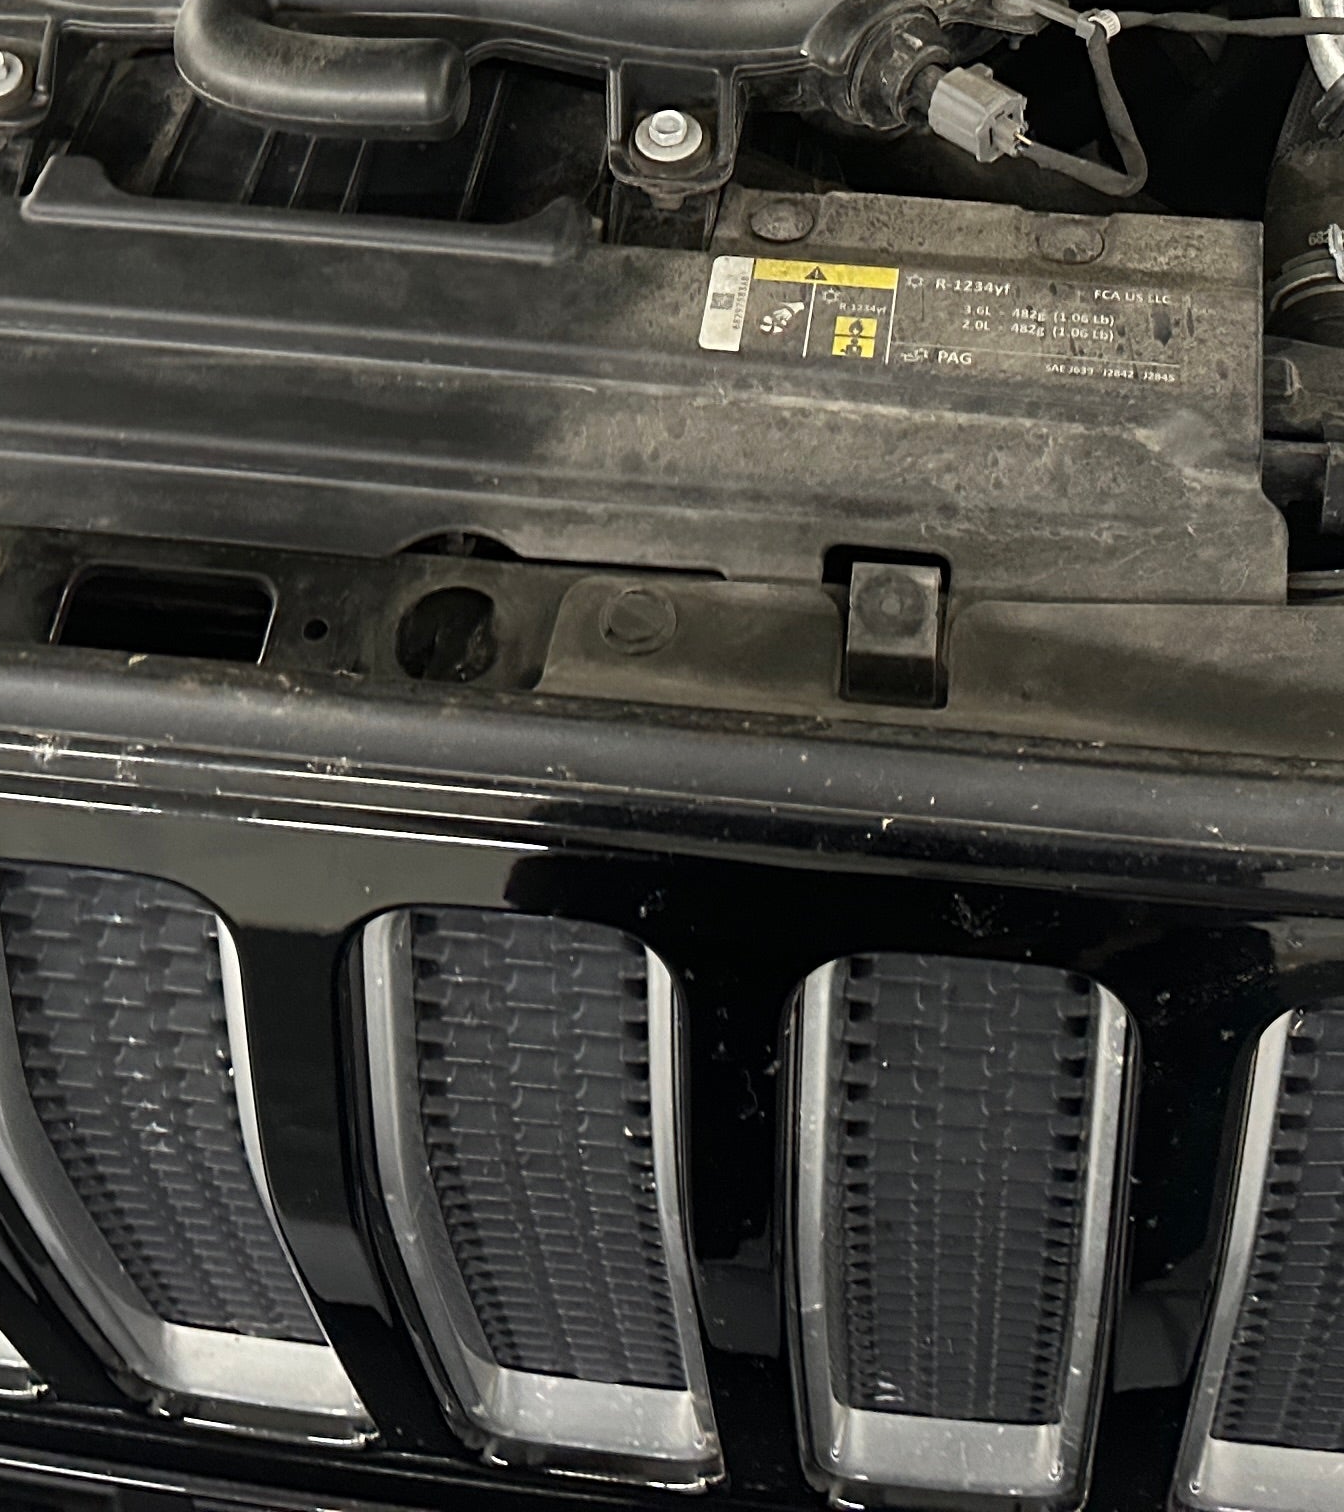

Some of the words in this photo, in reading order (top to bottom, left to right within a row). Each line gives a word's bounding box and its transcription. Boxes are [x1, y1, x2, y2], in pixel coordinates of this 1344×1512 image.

[935, 278, 1010, 297] R-1234yf
[1094, 290, 1121, 301] FCA
[1125, 292, 1143, 303] US
[937, 350, 972, 365] PAG
